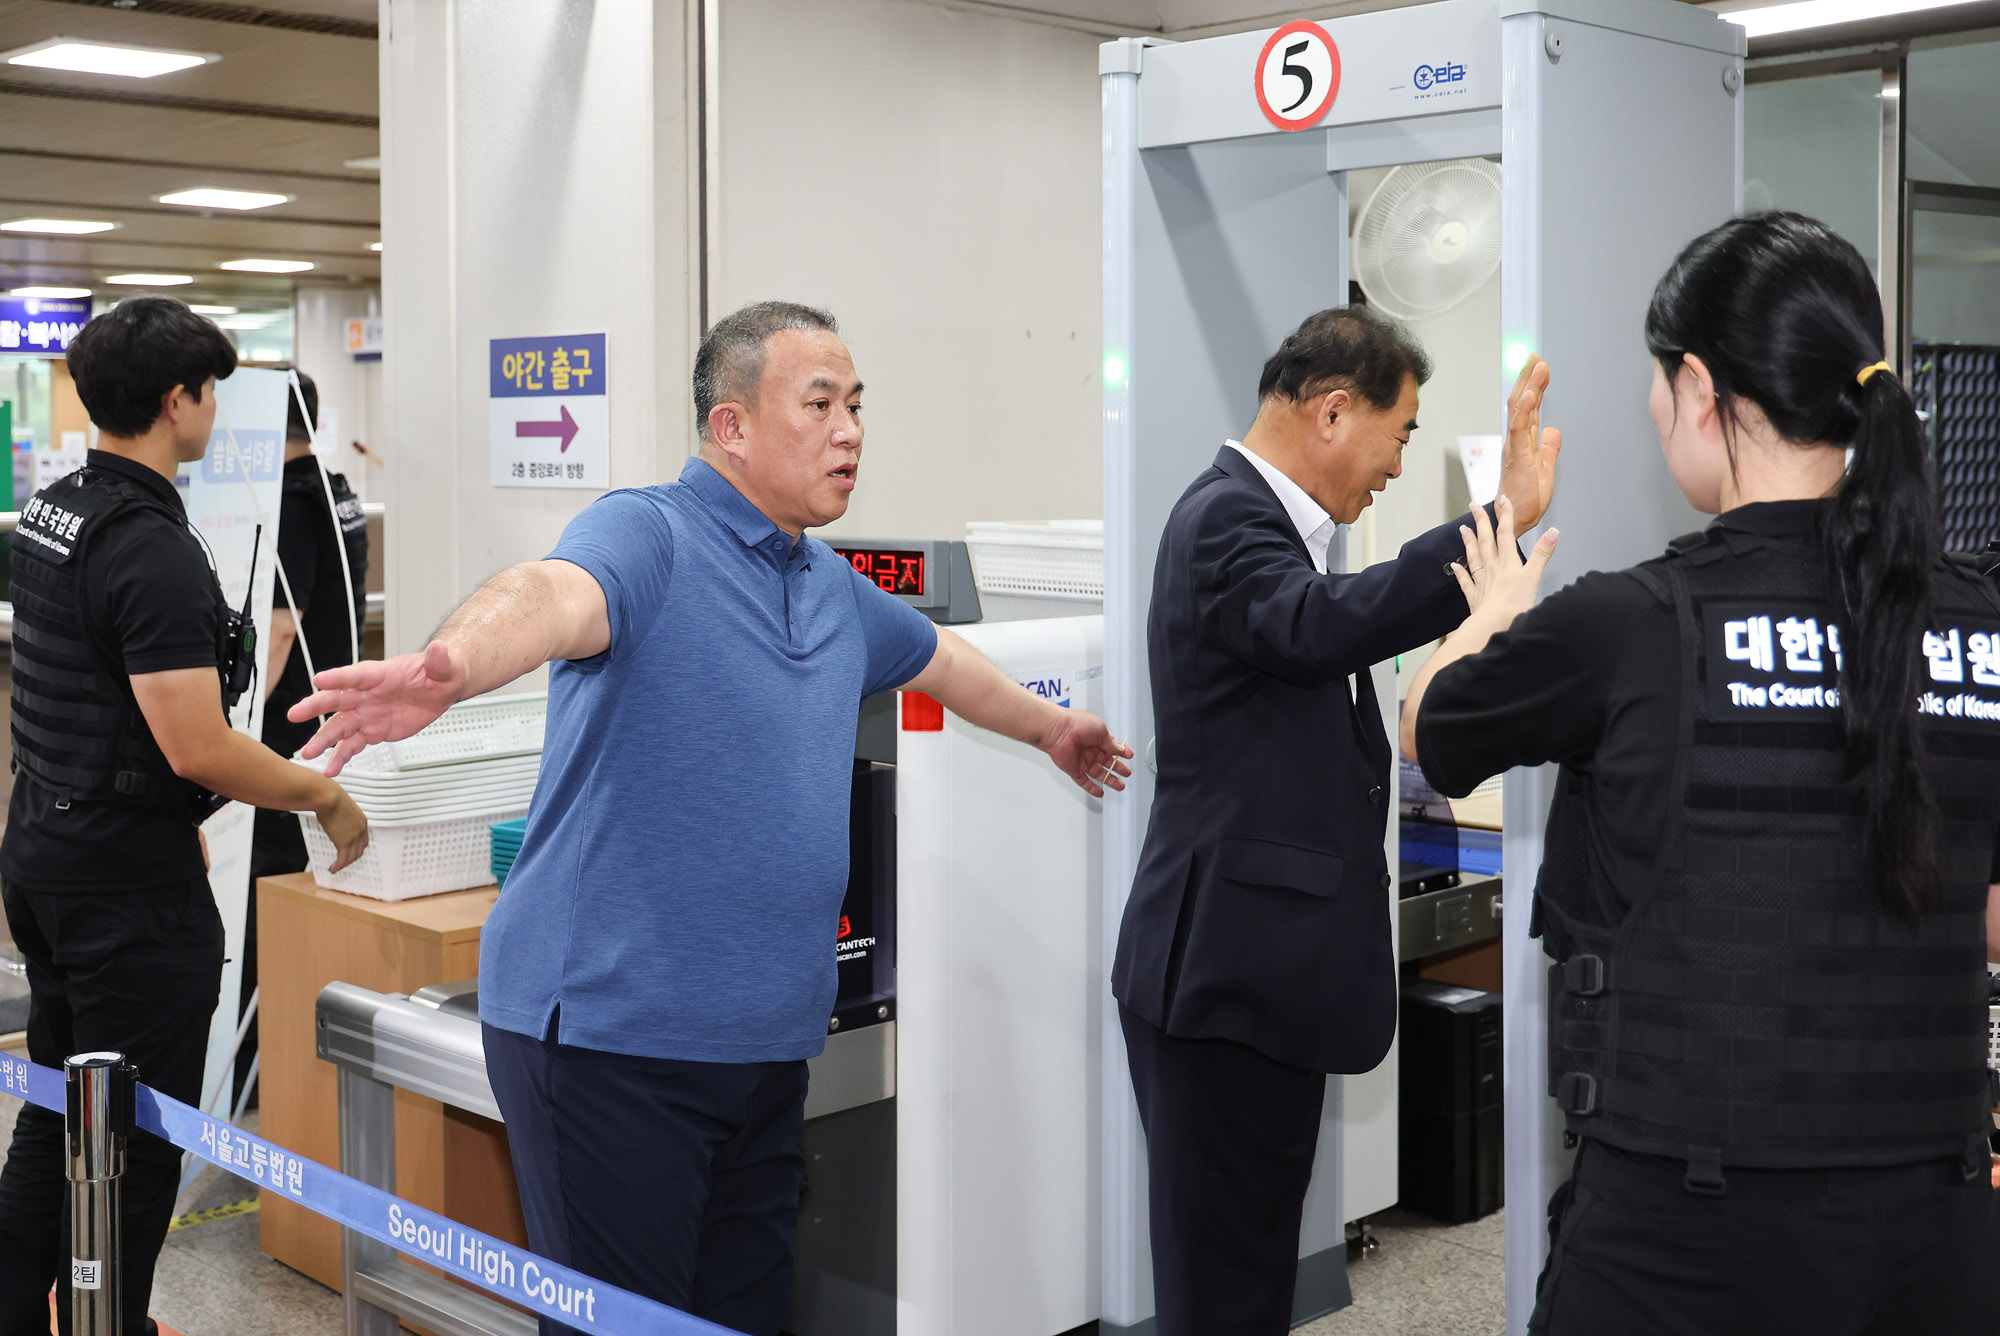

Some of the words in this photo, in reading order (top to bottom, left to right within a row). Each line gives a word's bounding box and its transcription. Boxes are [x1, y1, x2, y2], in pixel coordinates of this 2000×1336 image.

[1281, 39, 1313, 114] 5
[1414, 88, 1467, 100] www.ceia.net
[502, 350, 546, 390] 야간
[550, 346, 593, 391] 출구
[512, 461, 525, 479] 2층
[529, 462, 563, 479] 중앙로비
[567, 461, 584, 480] 방향
[1726, 681, 1768, 708] The
[1768, 681, 1824, 709] Court
[1945, 692, 1964, 717] of
[836, 936, 876, 952] CANTECH
[0, 1059, 29, 1094] 법원
[200, 1121, 304, 1197] 서울고등법원
[73, 1265, 96, 1284] 2팀
[388, 1203, 453, 1261] Seoul
[459, 1232, 516, 1289] High
[521, 1260, 596, 1323] Court
